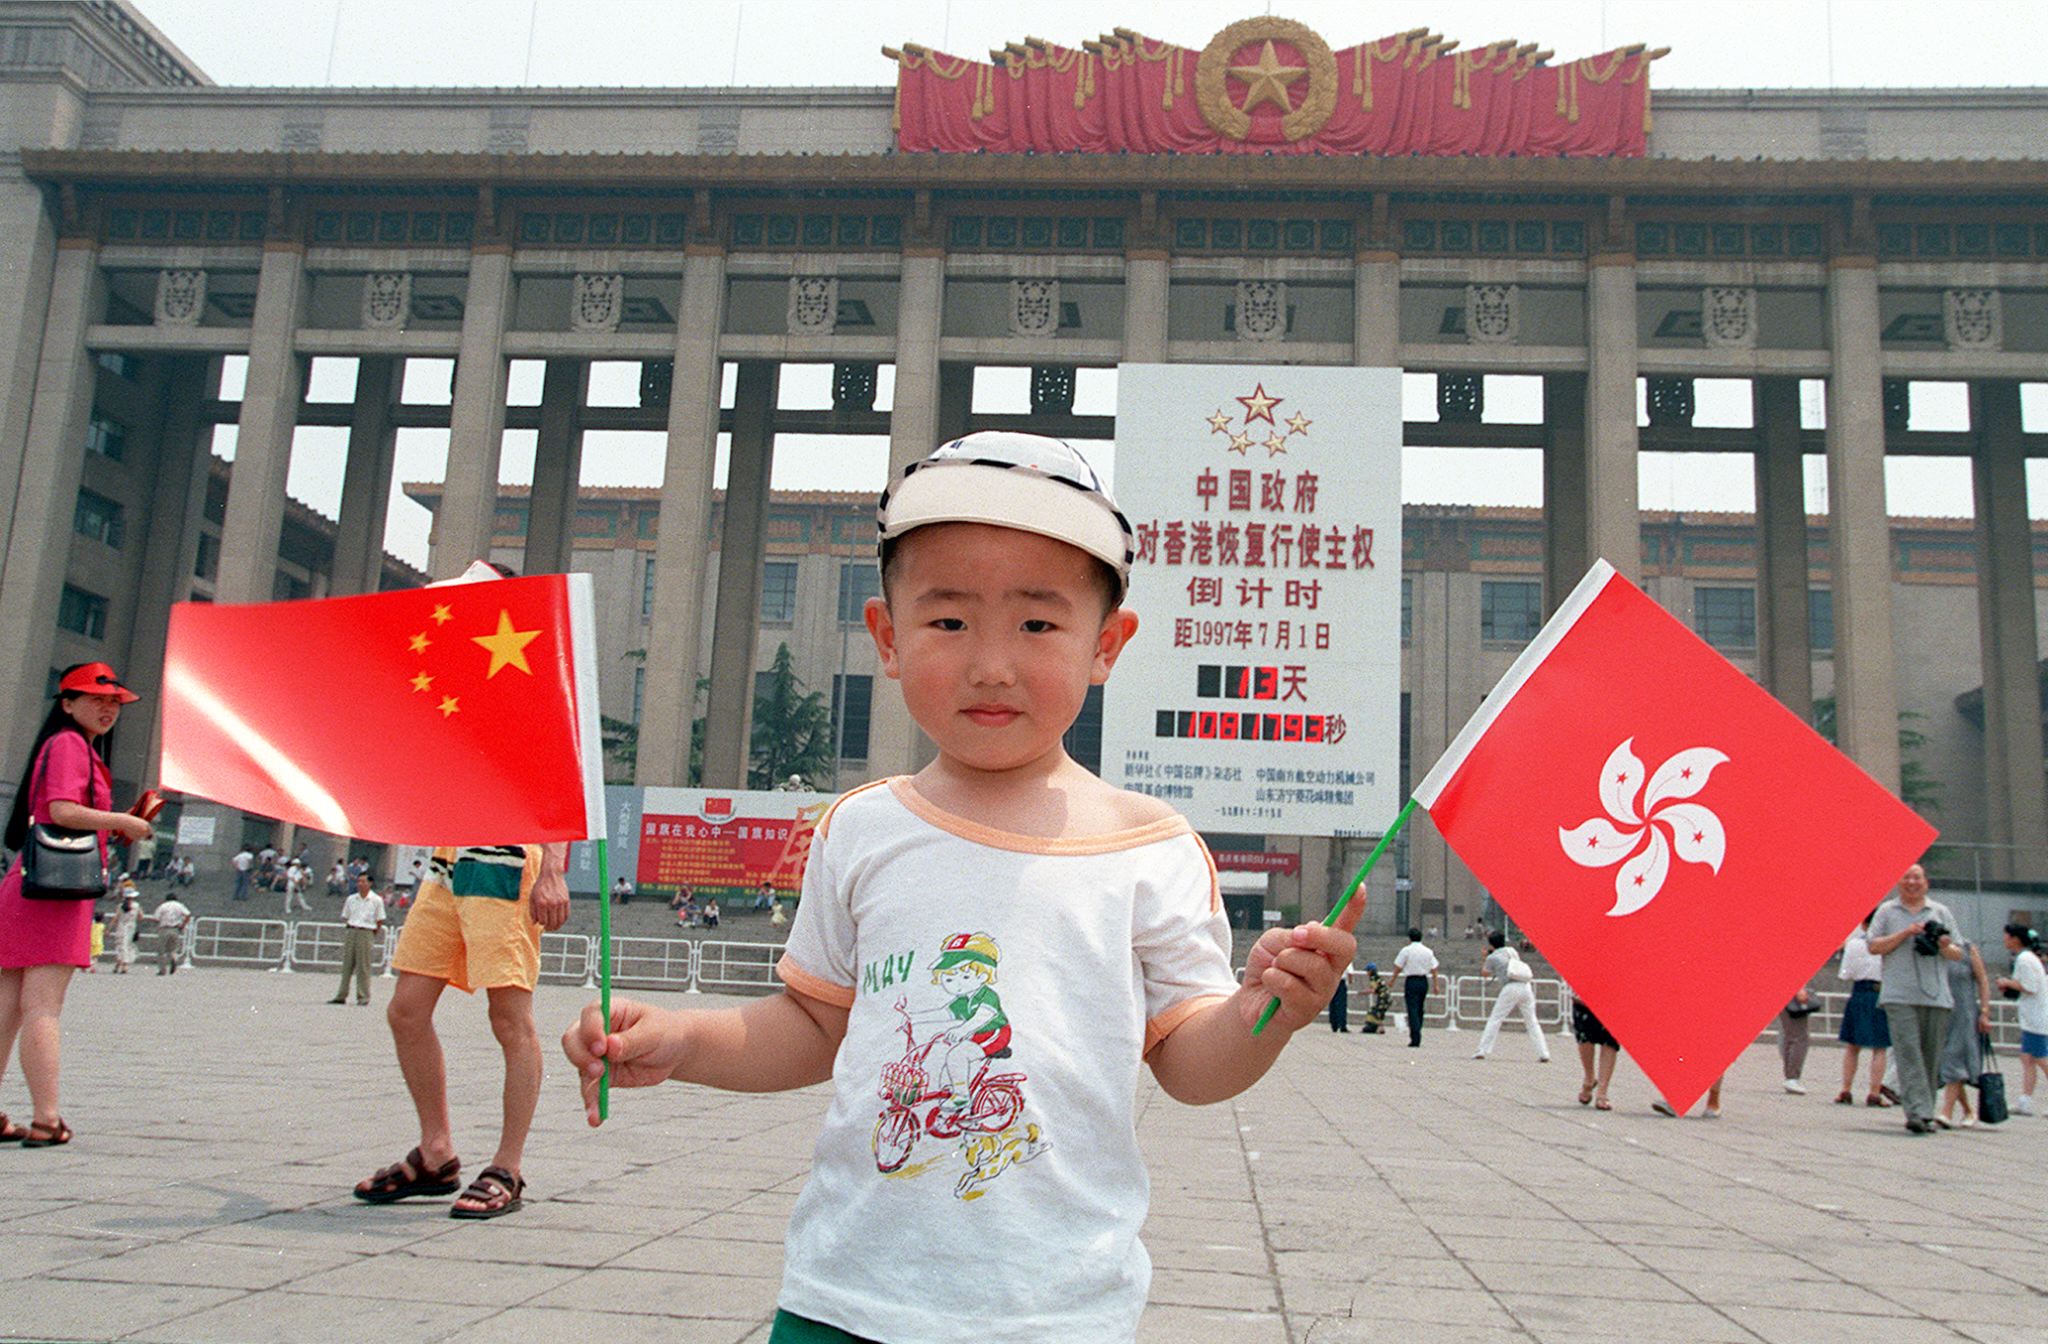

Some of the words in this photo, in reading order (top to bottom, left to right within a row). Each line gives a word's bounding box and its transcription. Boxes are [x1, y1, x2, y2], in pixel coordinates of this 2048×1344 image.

[1196, 466, 1319, 514] 中国政府
[1136, 519, 1375, 570] 对香港恢复行使主权
[1186, 576, 1323, 610] 倒计时
[1174, 617, 1330, 650] 距1997年7月1日
